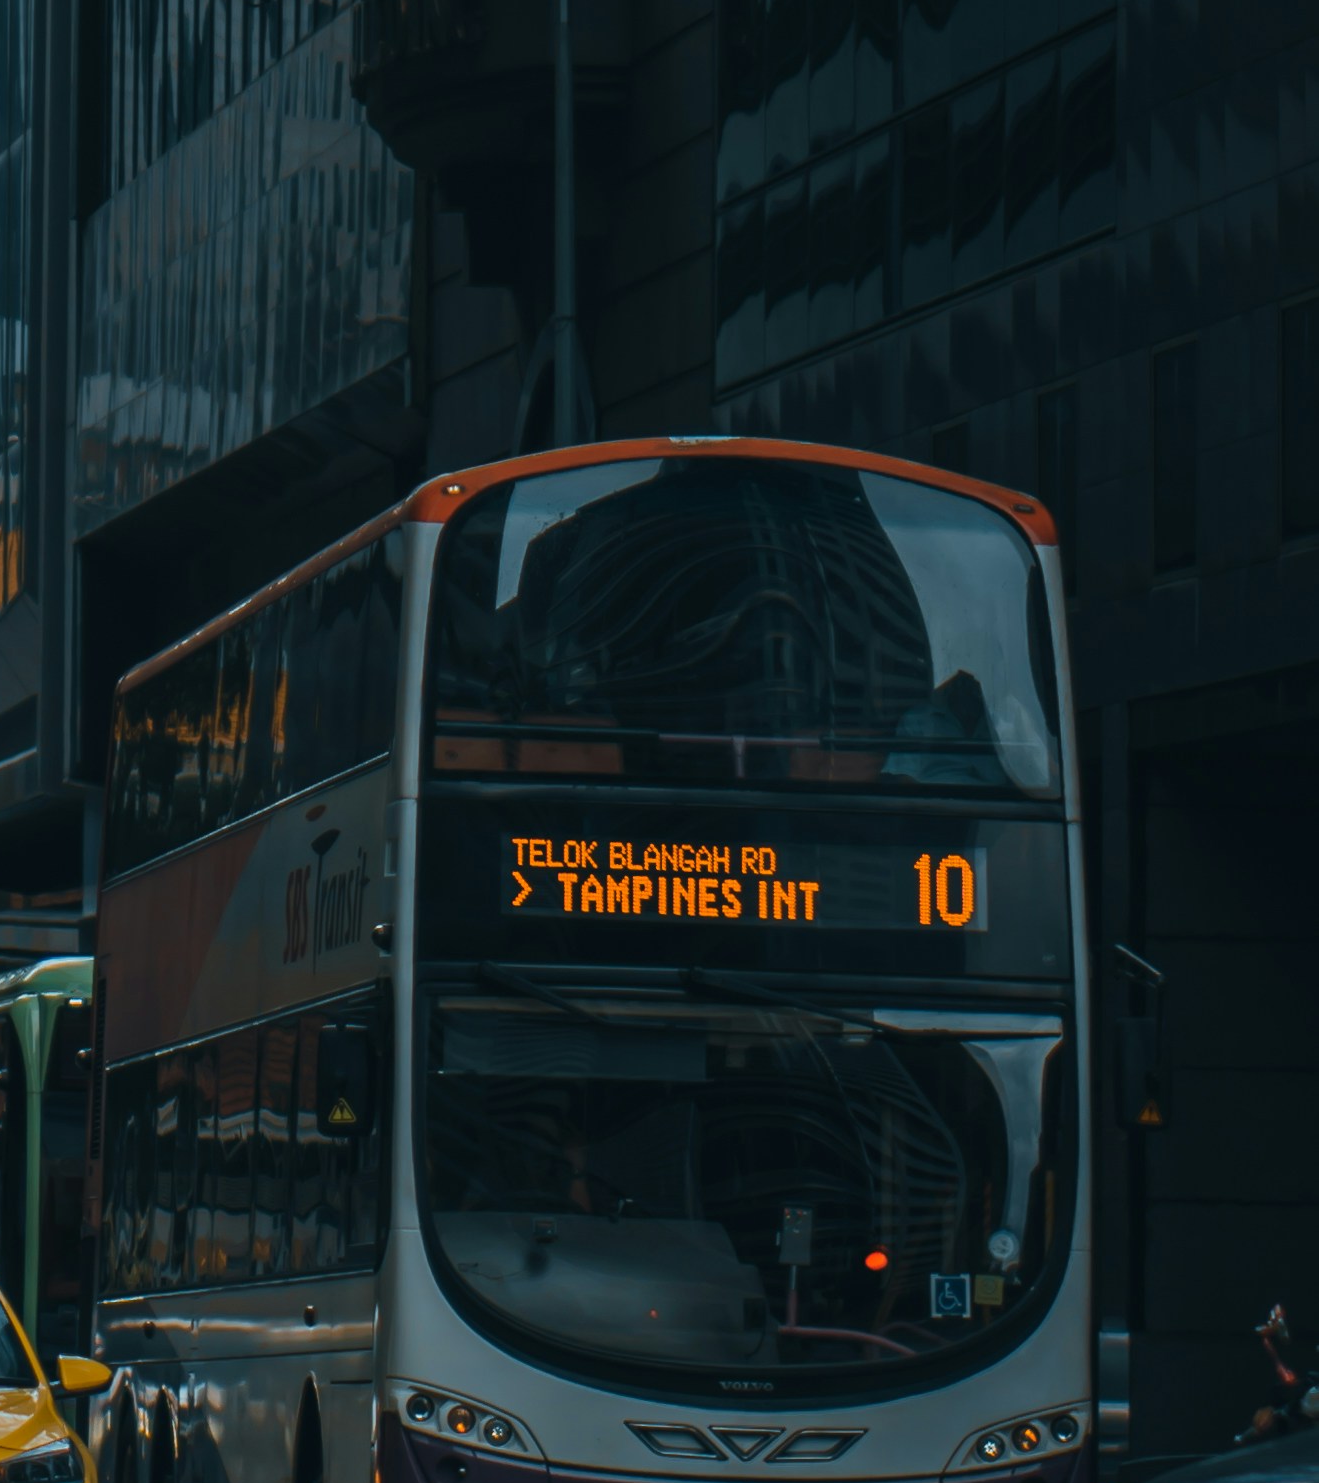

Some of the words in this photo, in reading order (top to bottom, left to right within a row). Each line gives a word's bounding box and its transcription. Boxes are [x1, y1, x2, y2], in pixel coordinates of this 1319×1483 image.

[512, 838, 599, 869] TELOK
[609, 841, 731, 874] BLANGAH
[741, 846, 777, 875] RD
[282, 864, 311, 965] SBS
[557, 872, 743, 919] TAMPINES
[758, 880, 820, 921] INT
[913, 853, 974, 927] 10
[718, 1380, 775, 1392] VOLVO
